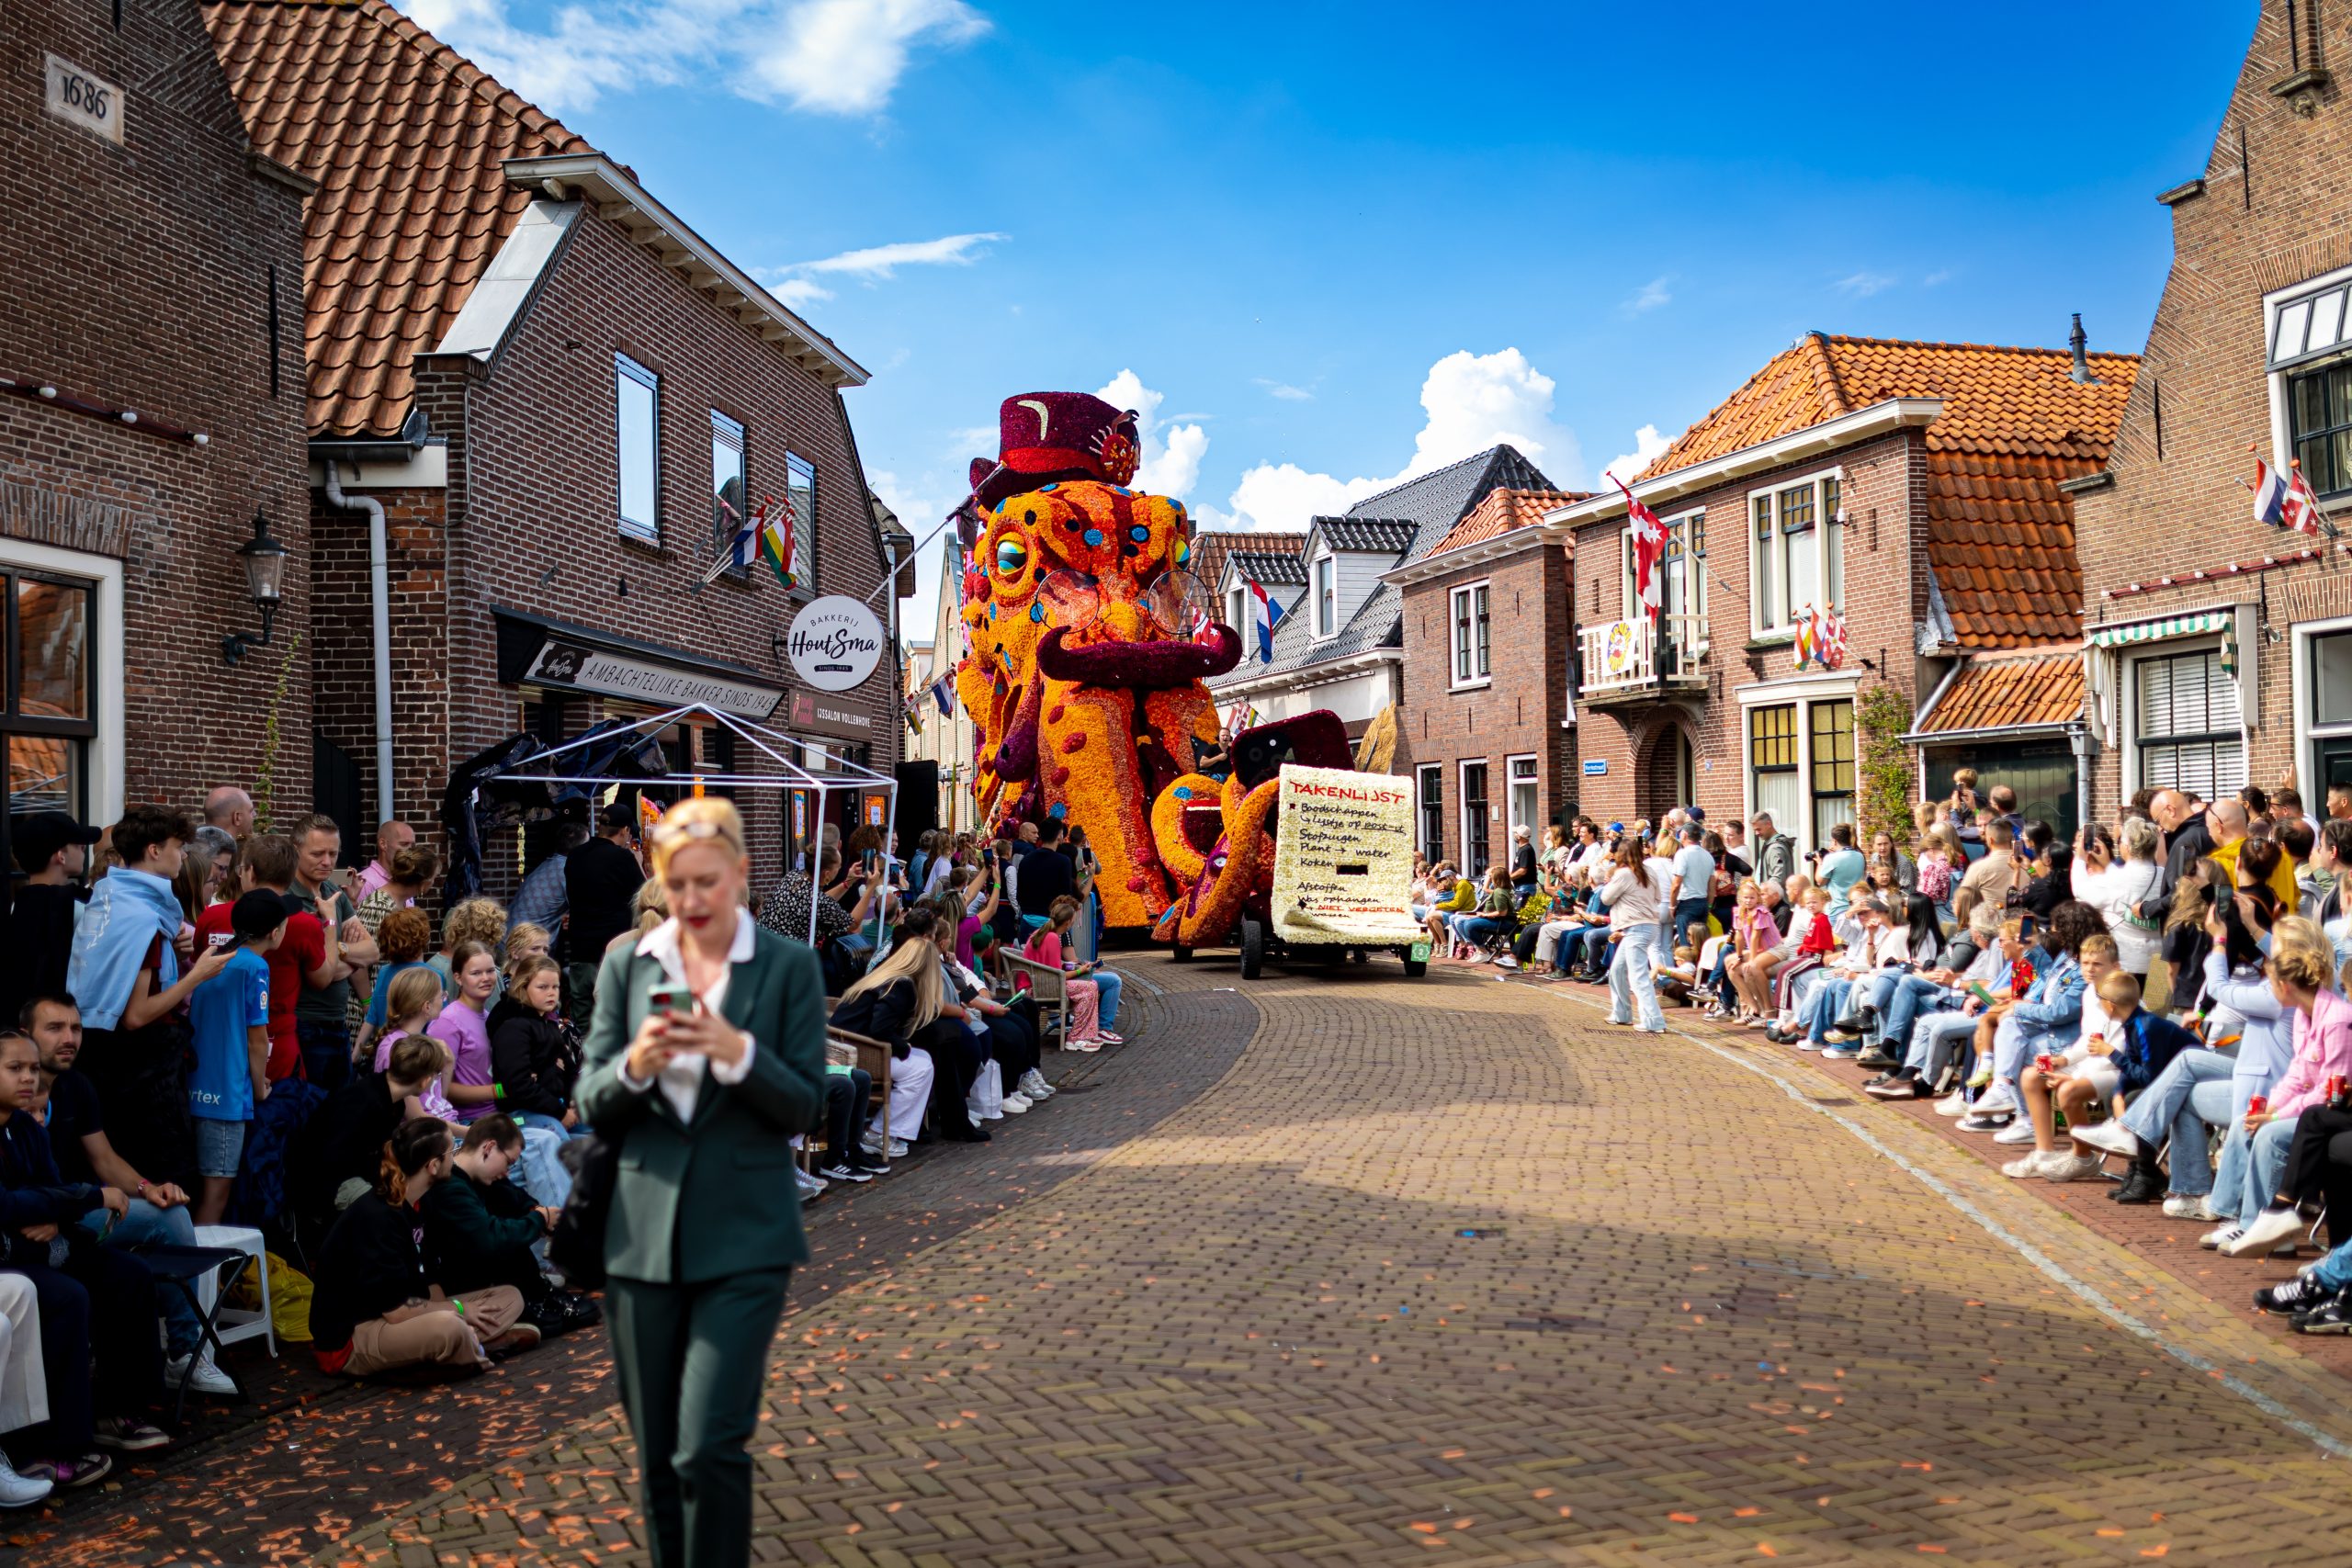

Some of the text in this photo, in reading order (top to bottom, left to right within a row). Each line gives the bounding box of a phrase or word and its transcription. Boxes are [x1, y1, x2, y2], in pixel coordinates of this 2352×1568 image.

[62, 75, 110, 119] 1686
[809, 614, 859, 627] BAKKERIJ
[790, 628, 879, 660] HoutSma
[584, 662, 683, 695] AMBACHTELIJKE
[681, 681, 723, 702] BAKKER
[720, 689, 753, 708] SINDS
[751, 694, 775, 711] 1945
[817, 707, 841, 722] IJSSALON
[841, 712, 871, 728] VOLLENHOVE
[1290, 781, 1406, 805] TAKENLIJST
[1301, 803, 1378, 818] Boodschappen
[1348, 820, 1362, 829] op
[1363, 821, 1405, 834] post-it
[1299, 829, 1362, 843] Stofzuigen
[1300, 842, 1391, 859] Plant water
[1300, 857, 1334, 867] Koken
[1296, 881, 1348, 893] Afstoffen
